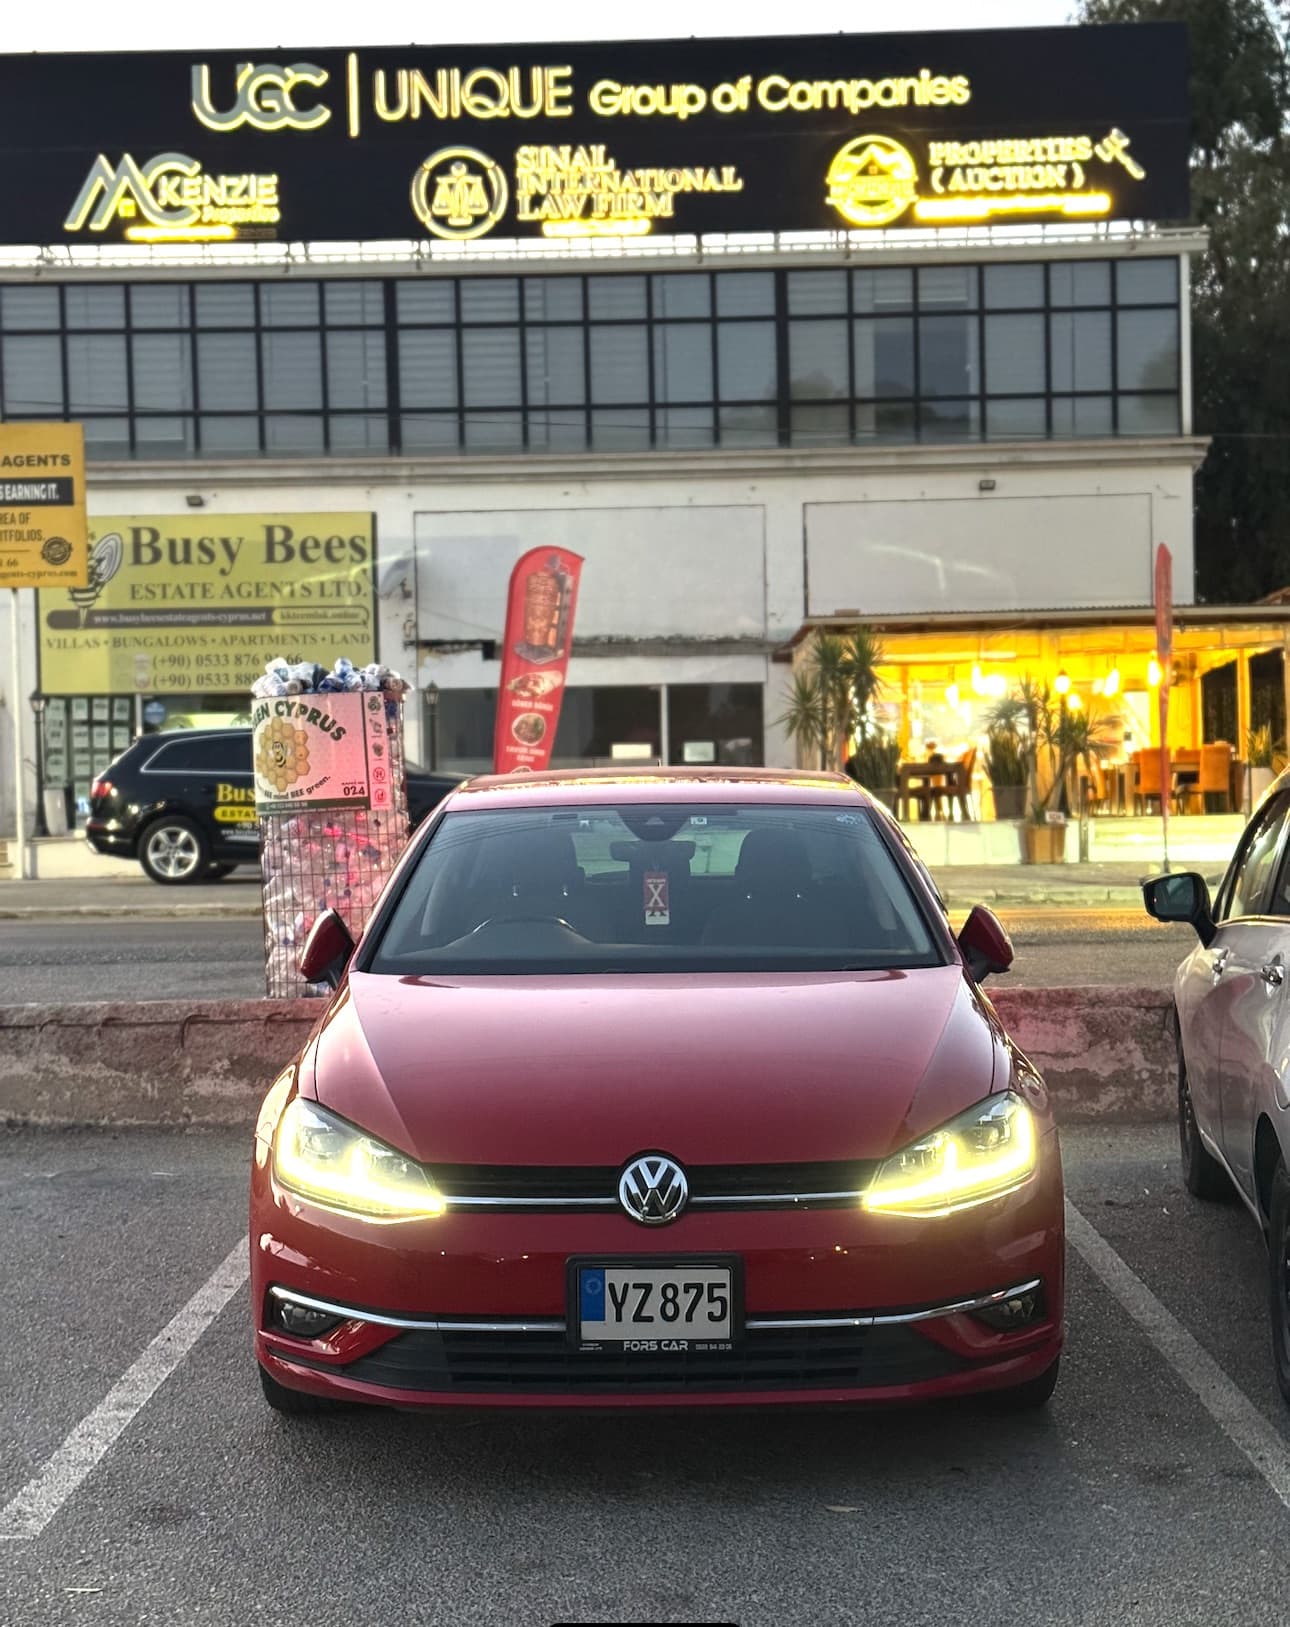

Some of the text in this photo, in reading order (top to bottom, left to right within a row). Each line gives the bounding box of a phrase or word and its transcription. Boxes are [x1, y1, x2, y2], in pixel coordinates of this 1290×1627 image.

[191, 62, 971, 132] UGC UNIQUE Group of Companies
[928, 136, 1093, 166] PROPERTIES
[517, 167, 743, 195] INTERNATIONAL
[517, 192, 674, 221] LAW FIRM
[1, 454, 71, 468] AGENTS
[5, 483, 47, 500] EARNING
[19, 512, 31, 525] OF
[129, 525, 368, 575] Busy Bees
[130, 579, 368, 602] ESTATE AGENTS LTD.
[46, 632, 370, 650] VILLAS BUNGALOWS APARTMENTS LAND
[152, 653, 192, 668] (+90)
[195, 653, 230, 667] 0533
[234, 652, 260, 667] 876
[153, 673, 192, 688] (+90)
[196, 672, 230, 687] 0533
[275, 700, 347, 742] CYPRUS
[216, 783, 256, 802] Bus
[344, 785, 365, 797] 024
[623, 1341, 658, 1351] FORS
[661, 1340, 689, 1351] CAR
